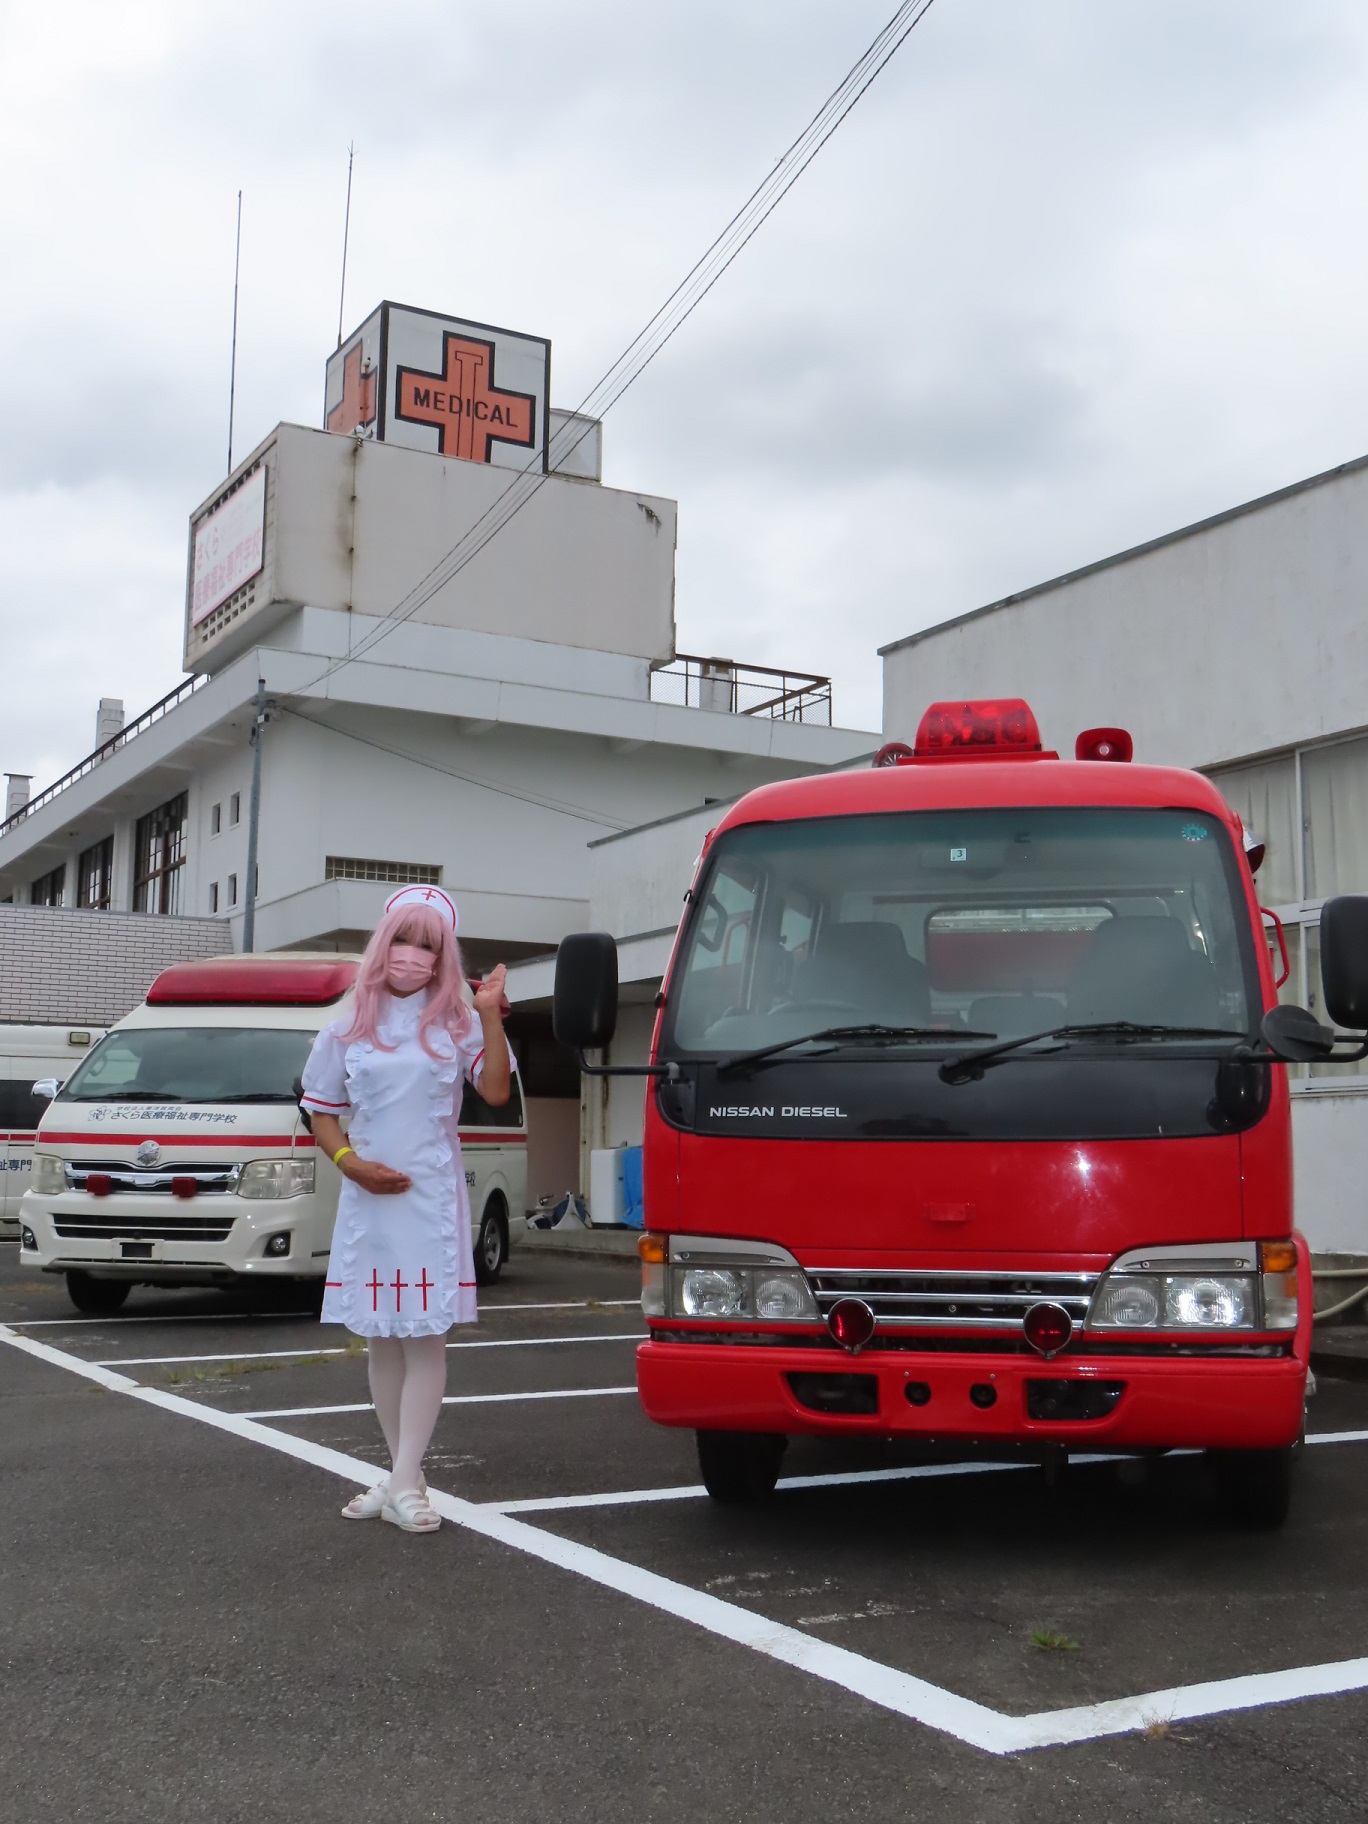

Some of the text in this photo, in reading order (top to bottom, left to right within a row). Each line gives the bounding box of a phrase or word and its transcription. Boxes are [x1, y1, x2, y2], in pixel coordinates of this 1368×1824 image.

[413, 387, 518, 428] MEDICAL
[110, 1110, 238, 1125] さくら医療福祉専門学校
[709, 1106, 848, 1118] NISSAN DIESEL
